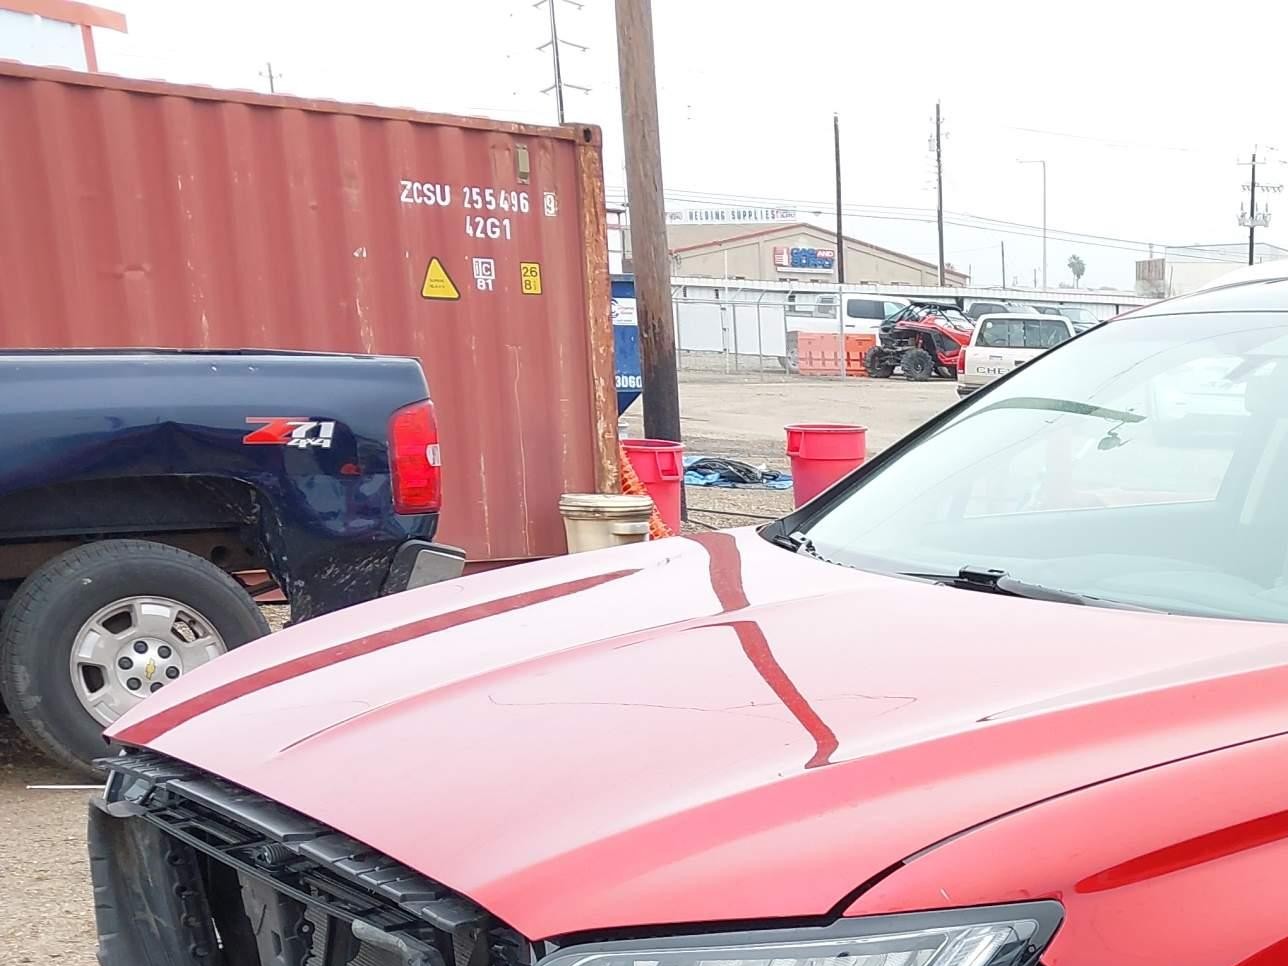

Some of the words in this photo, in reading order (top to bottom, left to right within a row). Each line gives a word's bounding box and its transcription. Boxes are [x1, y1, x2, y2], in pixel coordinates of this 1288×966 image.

[400, 180, 450, 206] ZCSU
[463, 186, 529, 213] 255496
[544, 193, 557, 217] 9
[465, 215, 511, 240] 42G1
[731, 209, 776, 220] SUPPLIES
[243, 416, 336, 445] Z71
